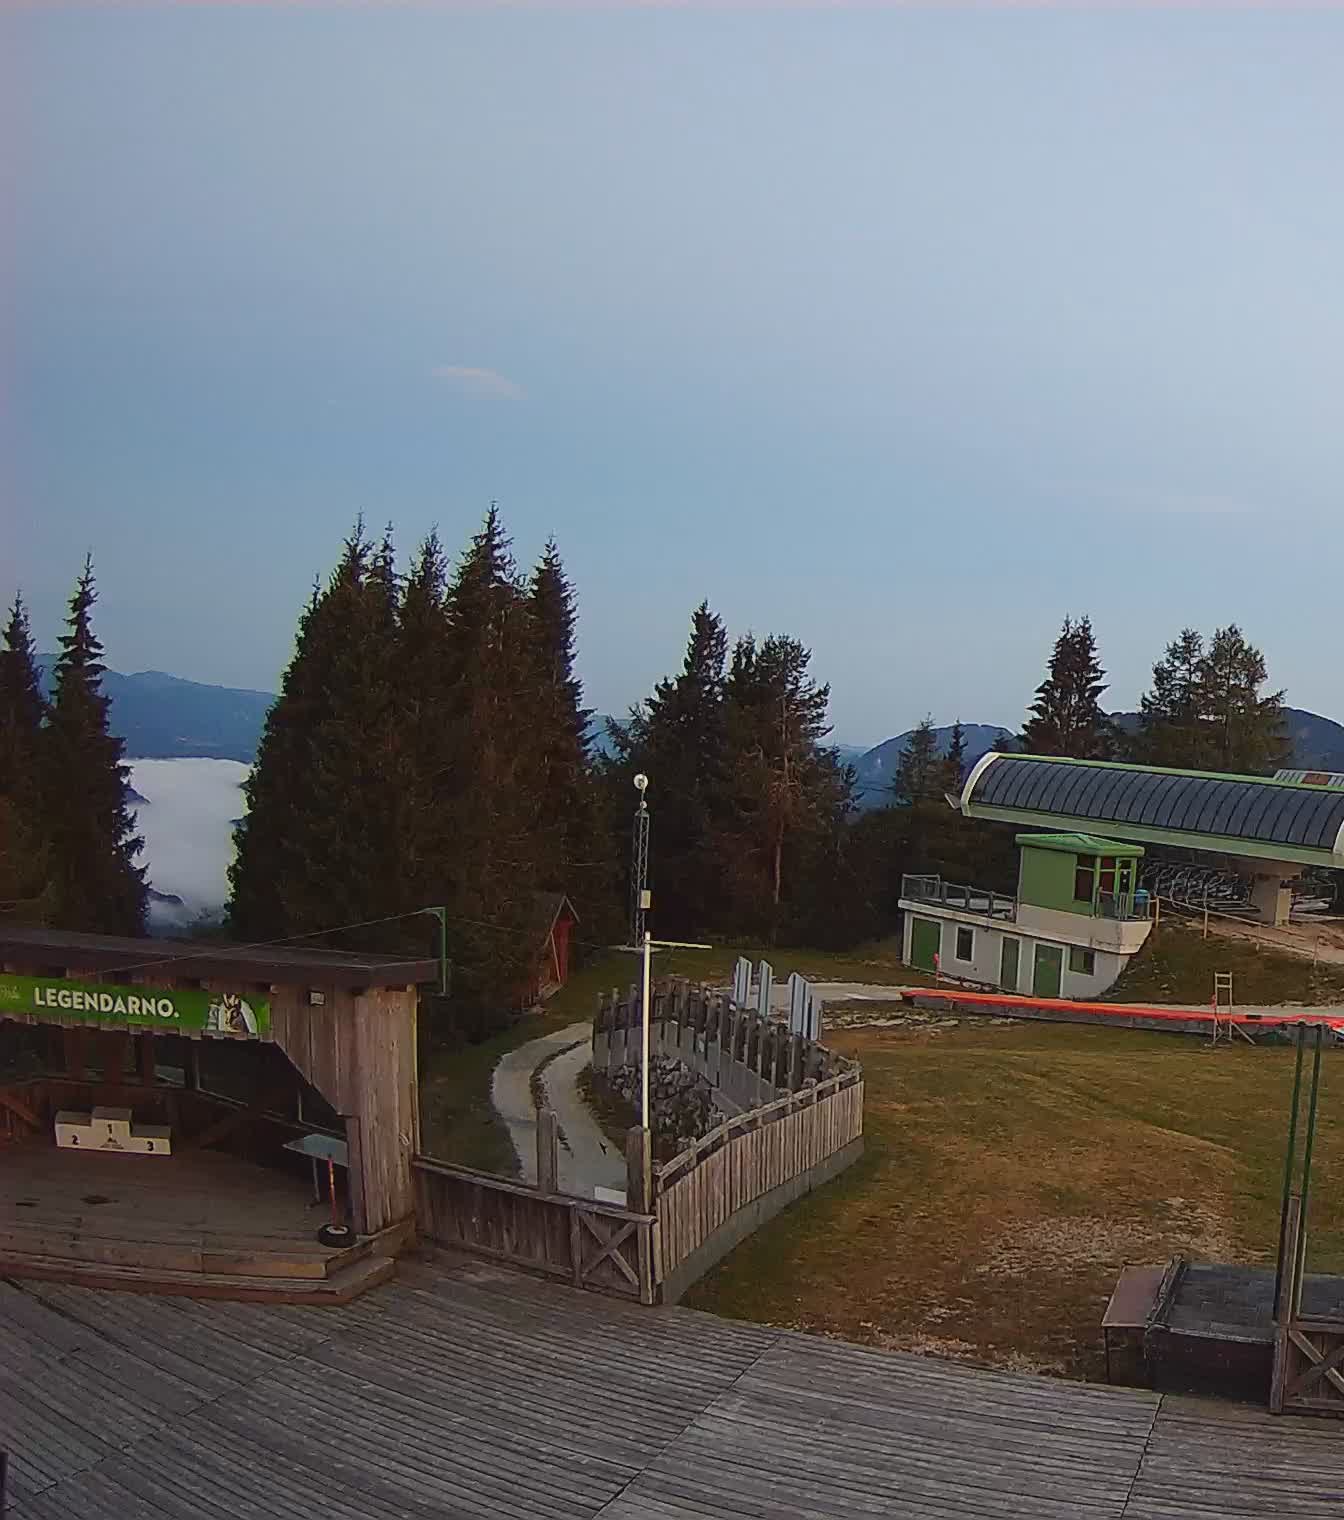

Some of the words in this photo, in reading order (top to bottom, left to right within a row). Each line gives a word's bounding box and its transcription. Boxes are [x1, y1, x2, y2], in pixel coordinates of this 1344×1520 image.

[34, 987, 180, 1018] LEGENDARNO.
[107, 1123, 113, 1135] 1
[72, 1134, 80, 1146] 2
[146, 1140, 154, 1152] 3
